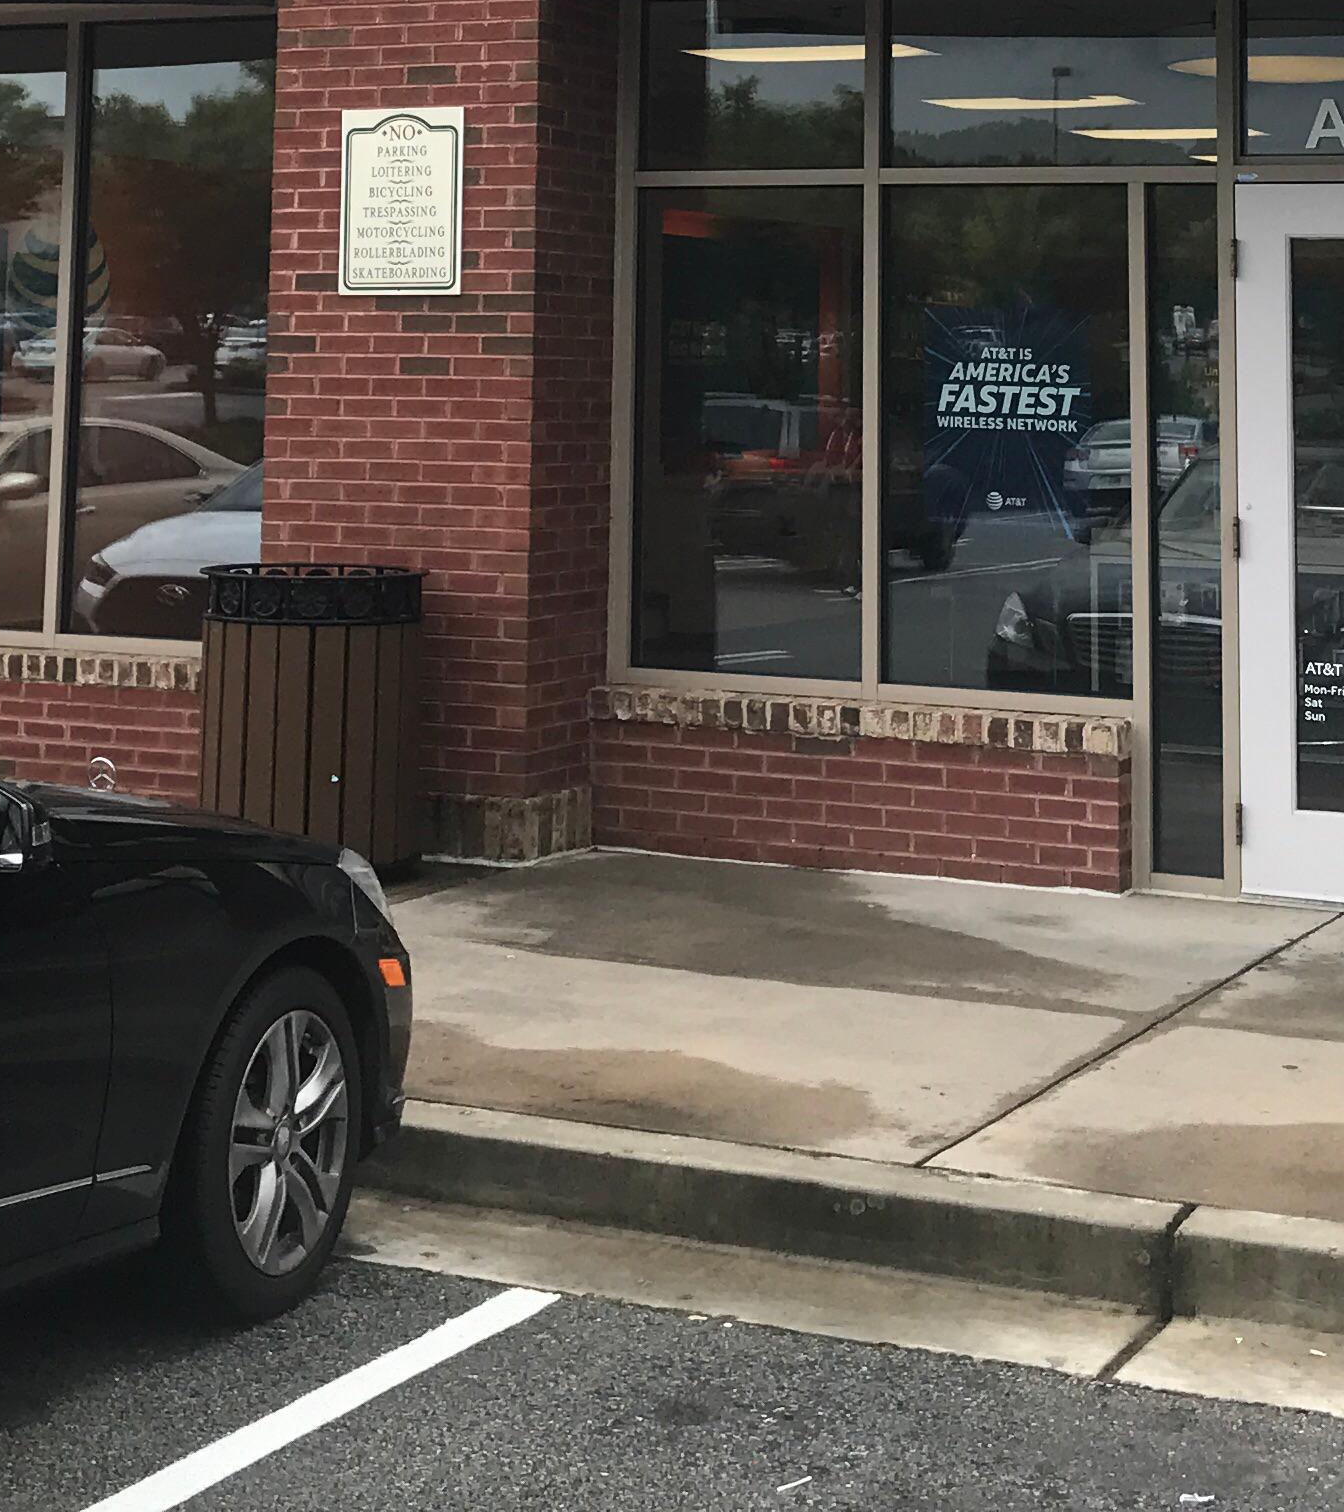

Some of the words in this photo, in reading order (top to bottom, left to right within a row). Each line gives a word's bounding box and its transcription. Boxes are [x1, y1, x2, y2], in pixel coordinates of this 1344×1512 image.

[389, 124, 416, 141] NO
[377, 145, 427, 158] PARKING
[371, 165, 432, 178] LOITERING
[368, 185, 433, 198] BICYCLING
[362, 205, 437, 218] TRESPASSING
[356, 225, 445, 239] MOTORCYCLING
[353, 246, 445, 259] ROLLERBLADING
[352, 266, 447, 280] SKATEBOARDING
[980, 346, 1016, 360] AT&T
[1019, 348, 1033, 360] IS
[948, 362, 1071, 384] AMERICA'S
[937, 383, 1081, 416] FASTEST
[936, 415, 1004, 430] WIRELESS
[1006, 418, 1078, 433] NETWORK
[1004, 497, 1027, 507] AT&T
[1305, 662, 1343, 677] AT&T
[1304, 697, 1323, 709] Sat
[1304, 711, 1326, 722] Sun
